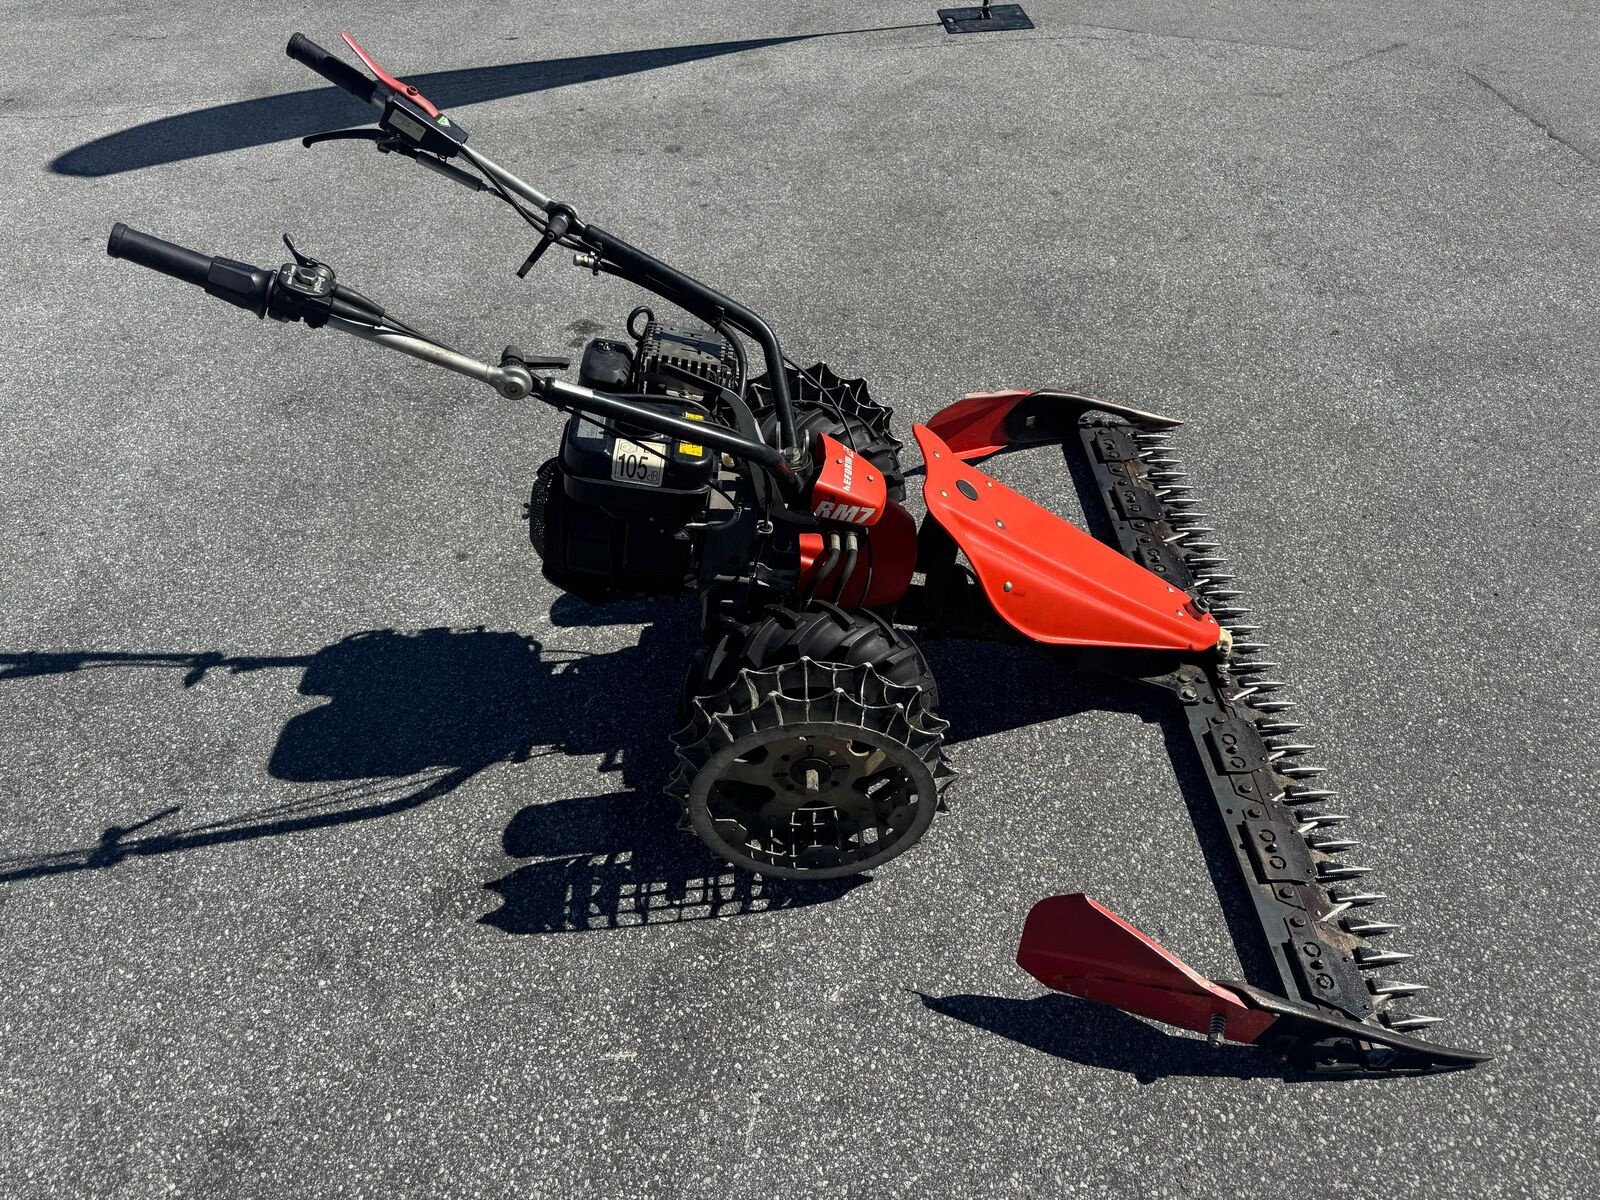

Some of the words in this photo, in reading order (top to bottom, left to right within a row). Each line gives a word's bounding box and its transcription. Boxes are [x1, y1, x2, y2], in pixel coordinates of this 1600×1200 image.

[618, 453, 649, 480] 105
[647, 470, 659, 482] dB
[815, 500, 876, 524] RM7
